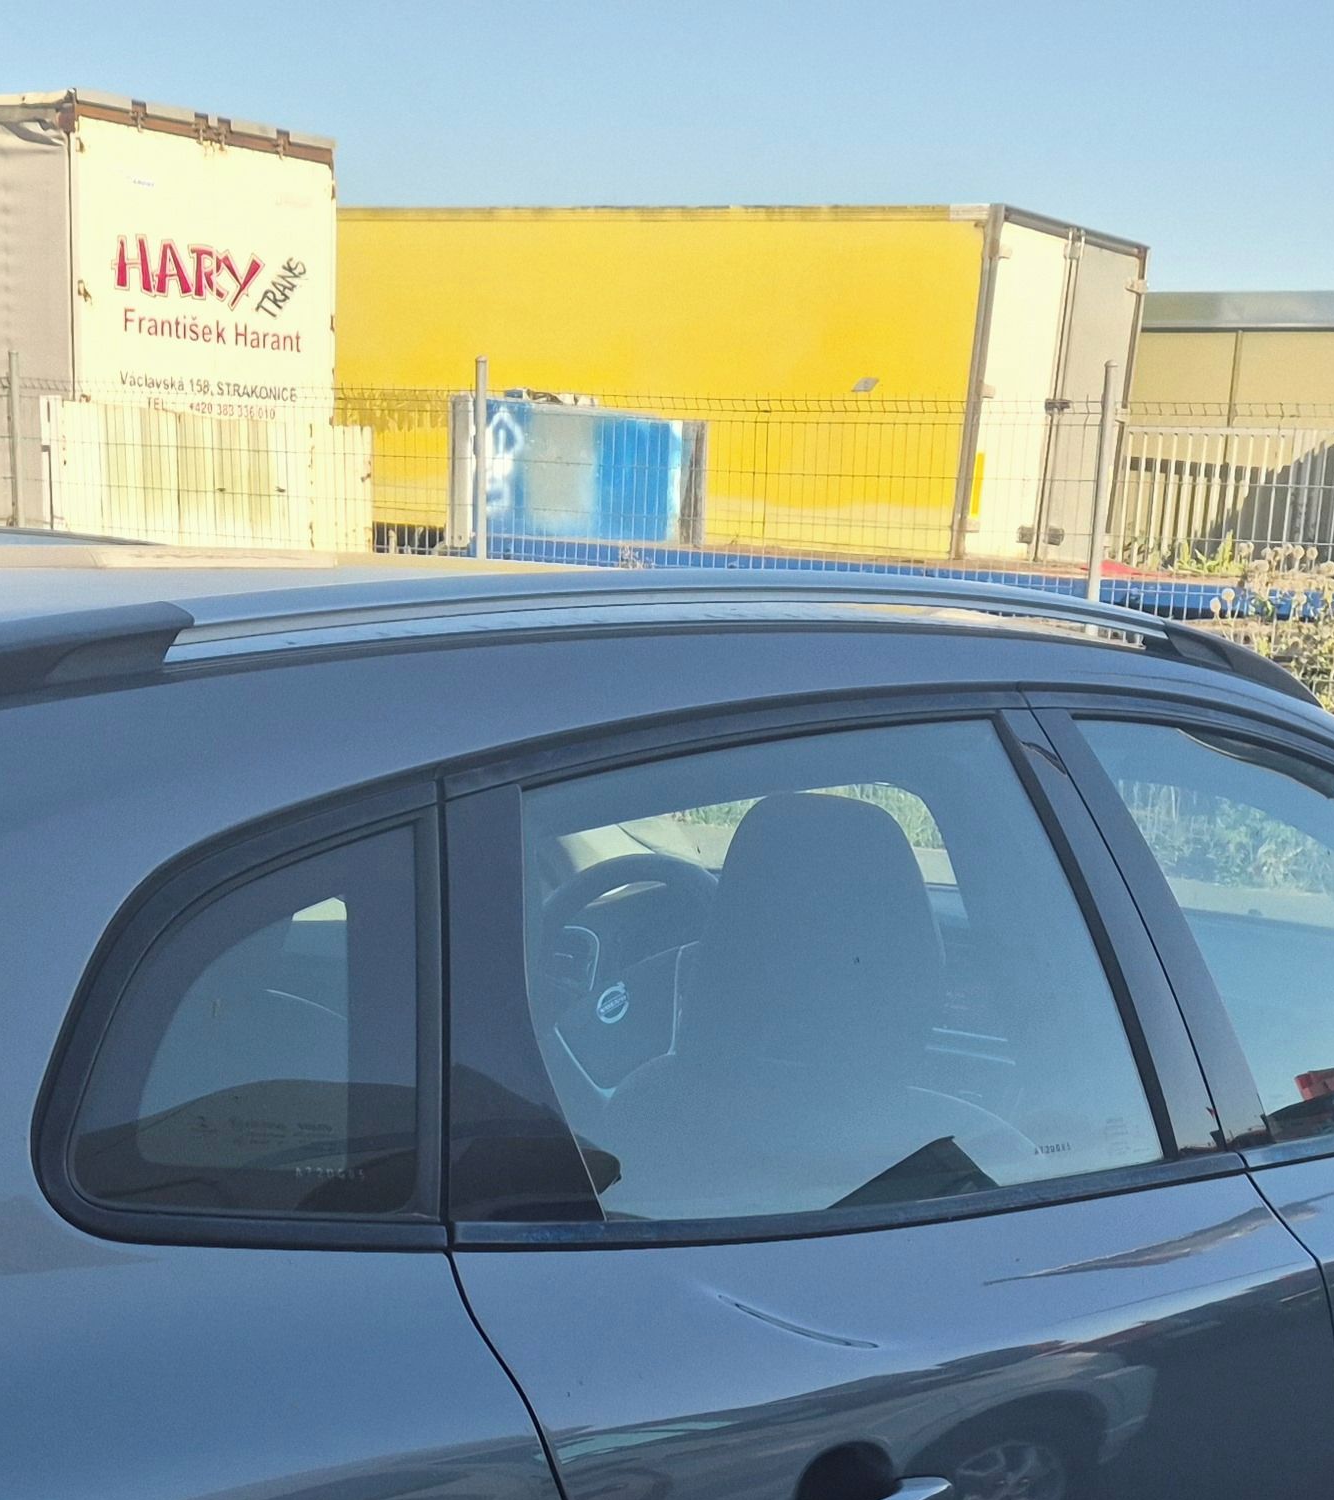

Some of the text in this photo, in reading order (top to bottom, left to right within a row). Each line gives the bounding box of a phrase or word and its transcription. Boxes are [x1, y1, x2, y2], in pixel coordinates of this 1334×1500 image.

[111, 233, 307, 320] HARY TRANS
[123, 307, 302, 353] František Harant
[216, 381, 298, 403] STRAKONICE
